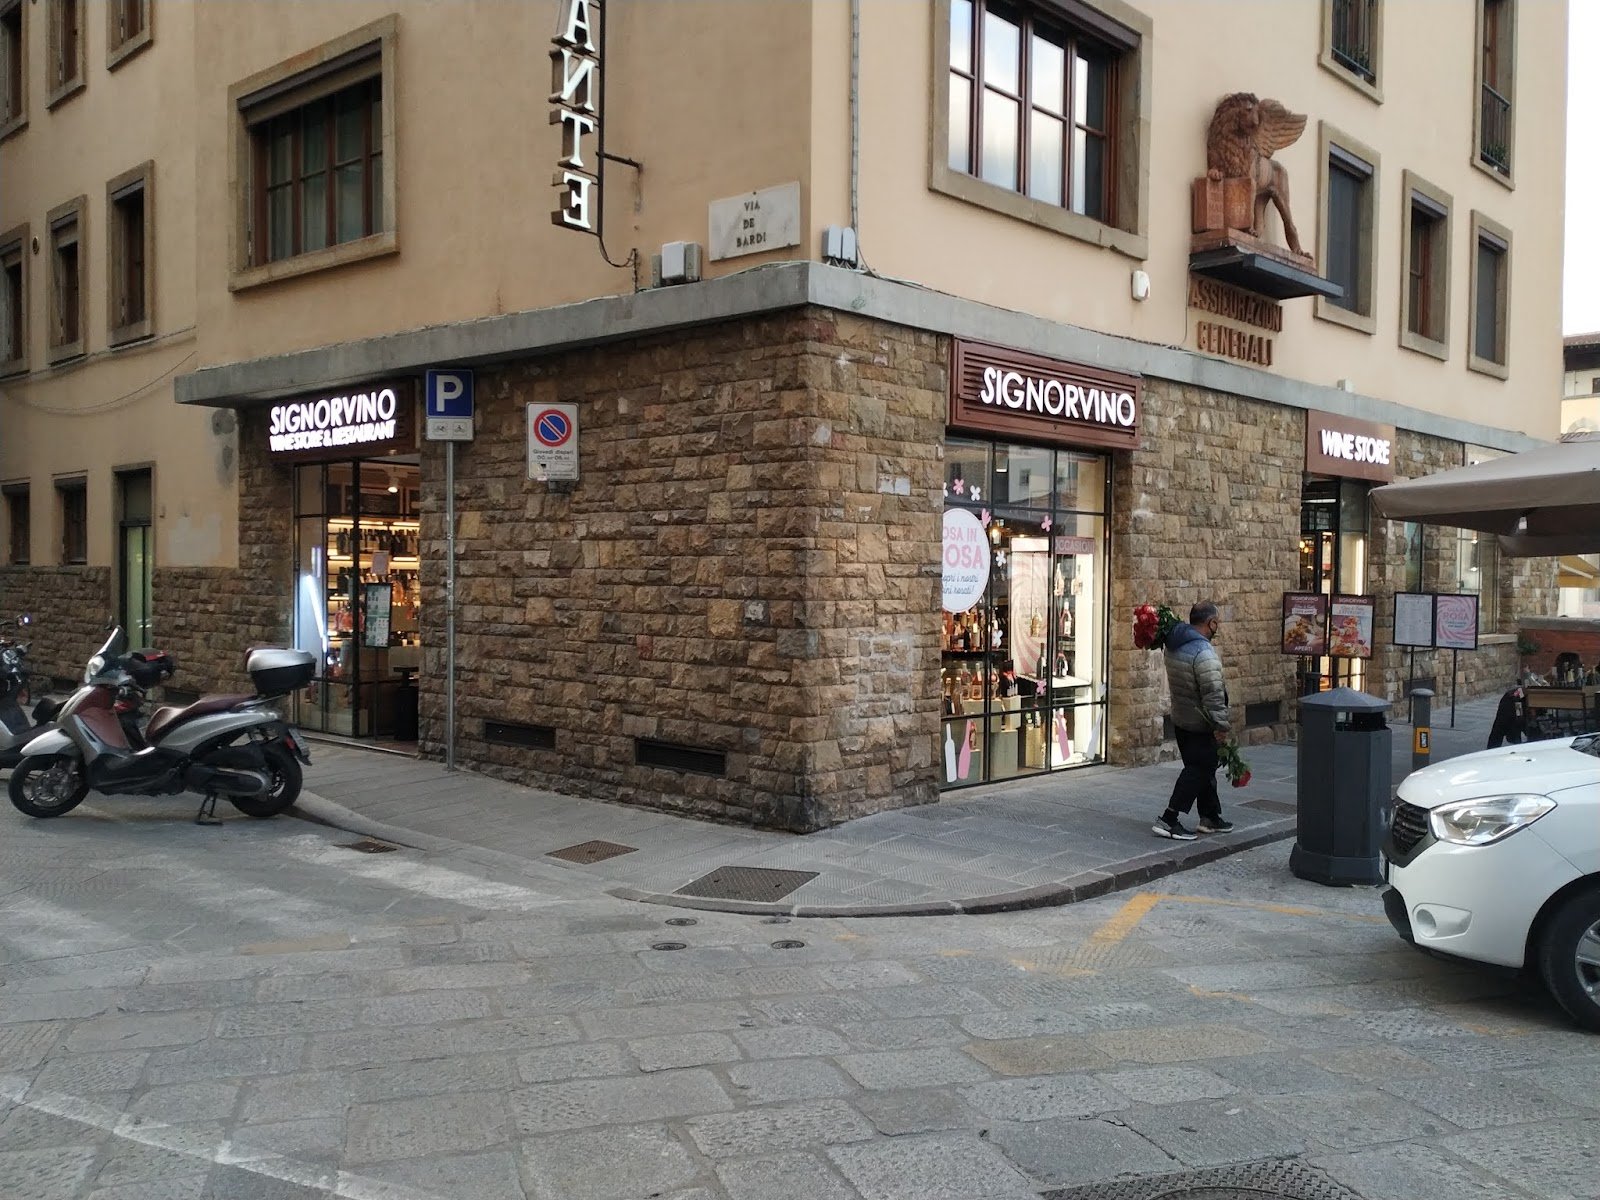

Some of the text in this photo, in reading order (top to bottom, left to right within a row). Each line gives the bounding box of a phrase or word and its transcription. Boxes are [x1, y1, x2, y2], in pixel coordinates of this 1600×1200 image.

[744, 200, 760, 211] VIA
[736, 232, 767, 248] BARDI
[743, 218, 755, 229] DE
[1198, 321, 1273, 366] GENERALI
[436, 375, 464, 412] P
[980, 366, 1136, 426] SIGNORVINO
[269, 388, 396, 434] SIGNORVINO
[269, 433, 295, 451] WINE
[294, 429, 323, 449] STORE
[332, 419, 396, 445] RESTAURANT
[1321, 428, 1391, 465] WINE STORE
[967, 527, 977, 542] IN
